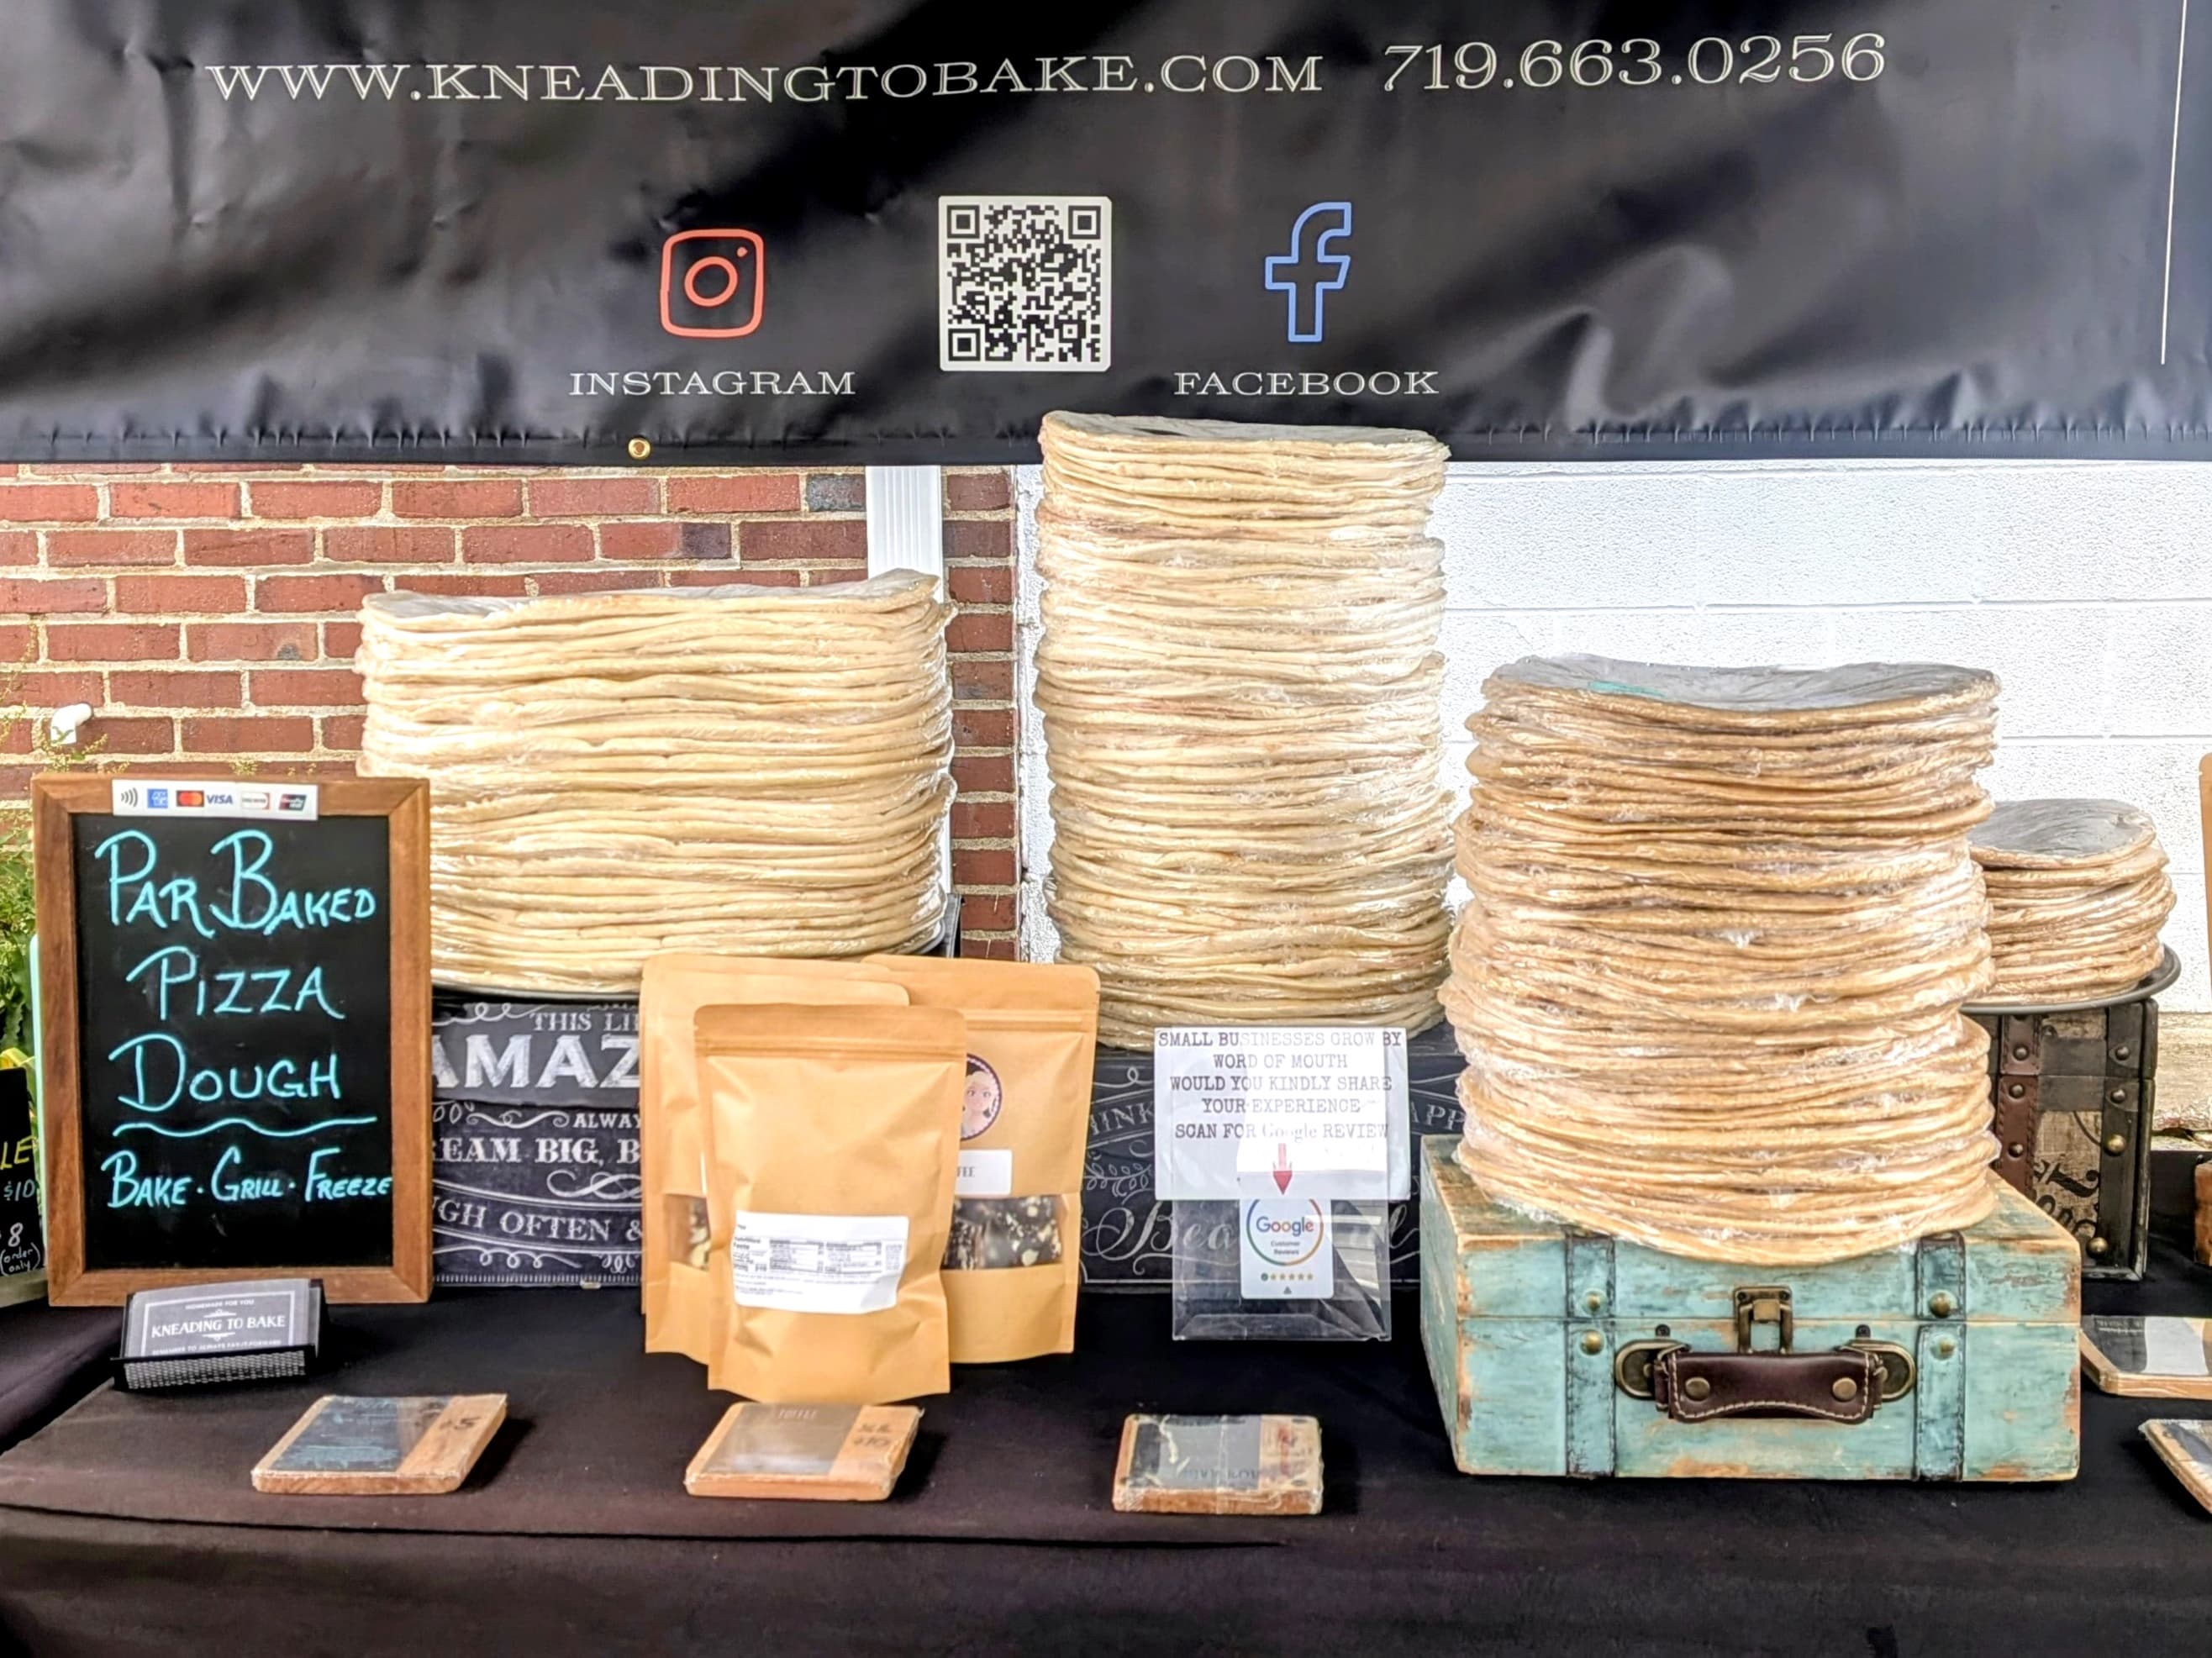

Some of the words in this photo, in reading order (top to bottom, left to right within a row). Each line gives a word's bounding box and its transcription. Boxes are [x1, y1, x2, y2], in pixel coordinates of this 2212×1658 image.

[205, 55, 1323, 103] WWW.KNEADINGTOBAKE.COM
[1383, 32, 1888, 92] 719.663.0256
[568, 370, 856, 397] INSTAGRAM
[1174, 370, 1440, 397] FACEBOOK
[207, 794, 234, 805] VISA
[94, 829, 215, 938] PAR
[208, 829, 377, 937] BAKED
[126, 945, 346, 1021] PIZZA
[529, 1012, 592, 1032] THIS
[604, 1012, 640, 1032] LI
[1158, 1031, 1214, 1047] SMALL
[1218, 1031, 1325, 1047] BUSINESSES
[1330, 1031, 1376, 1047] GROW
[1382, 1031, 1402, 1047] BY
[108, 1033, 342, 1113] DOUGH
[1213, 1054, 1258, 1069] WORD
[1263, 1054, 1287, 1069] OF
[1291, 1054, 1348, 1069] MOUTH
[1170, 1076, 1226, 1092] WOULD
[1231, 1076, 1263, 1092] YOU
[1269, 1076, 1332, 1092] KINDLY
[1336, 1076, 1393, 1092] SHARE
[1202, 1097, 1246, 1113] YOUR
[1251, 1097, 1361, 1113] EXPERIENCE
[1175, 1123, 1218, 1140] SCAN
[1223, 1123, 1256, 1140] FOR
[1323, 1123, 1390, 1140] REVIEW
[432, 1136, 522, 1164] EAM
[535, 1136, 604, 1166] BIG,
[304, 1148, 392, 1203] FREEZE
[432, 1195, 487, 1229] GH
[499, 1210, 613, 1242] OFTEN
[1256, 1215, 1314, 1238] Google
[151, 1319, 223, 1339] KNEADING
[226, 1317, 244, 1329] TO
[247, 1314, 287, 1329] BAKE
